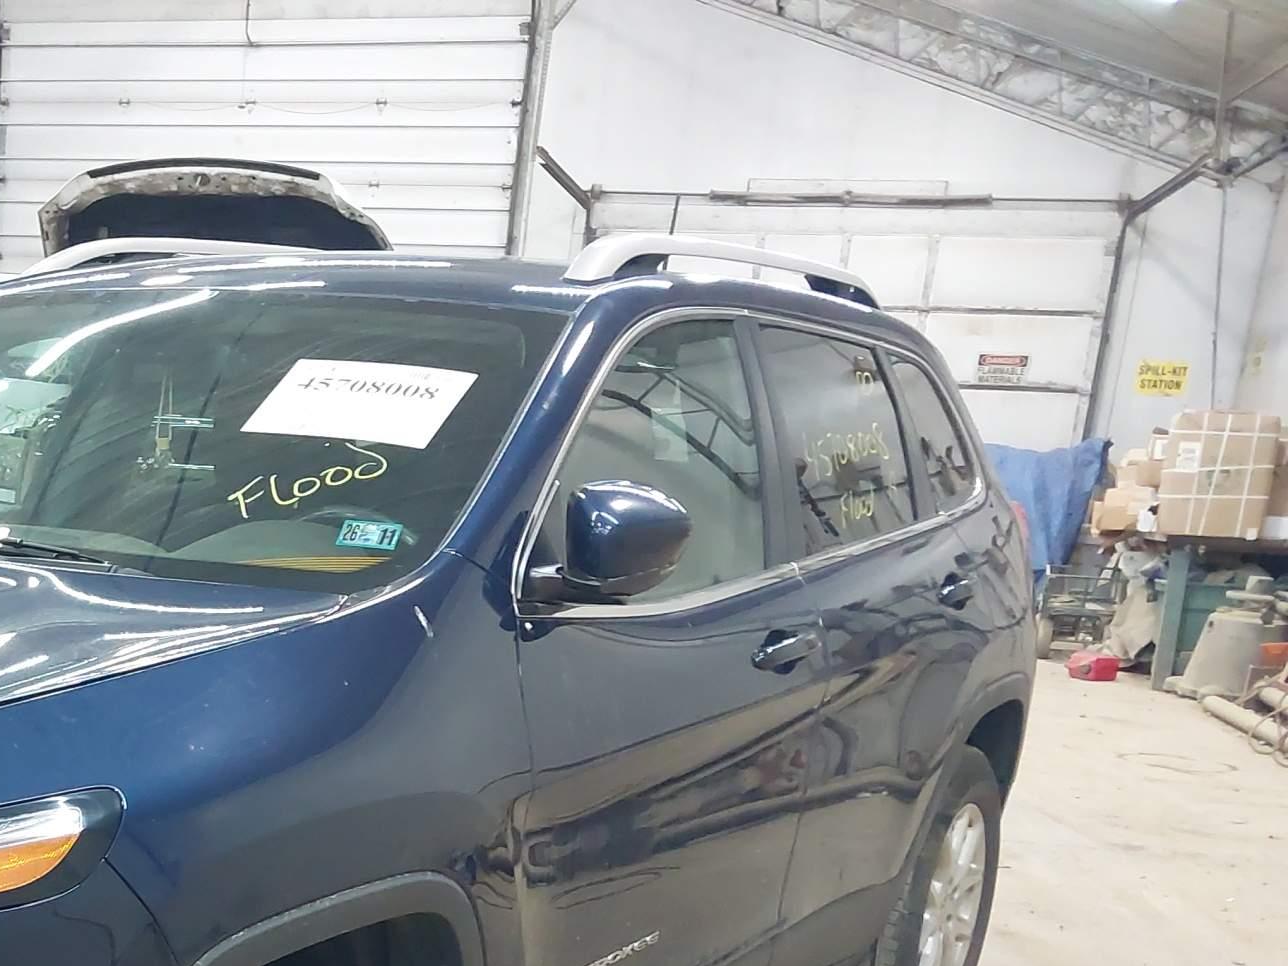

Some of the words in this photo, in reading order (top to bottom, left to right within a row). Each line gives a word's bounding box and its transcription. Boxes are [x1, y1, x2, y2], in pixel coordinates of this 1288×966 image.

[1138, 364, 1189, 377] SPILL-KIT
[296, 376, 440, 400] 45708008
[1139, 378, 1183, 390] STATION
[342, 524, 361, 541] 26
[377, 528, 397, 546] 11
